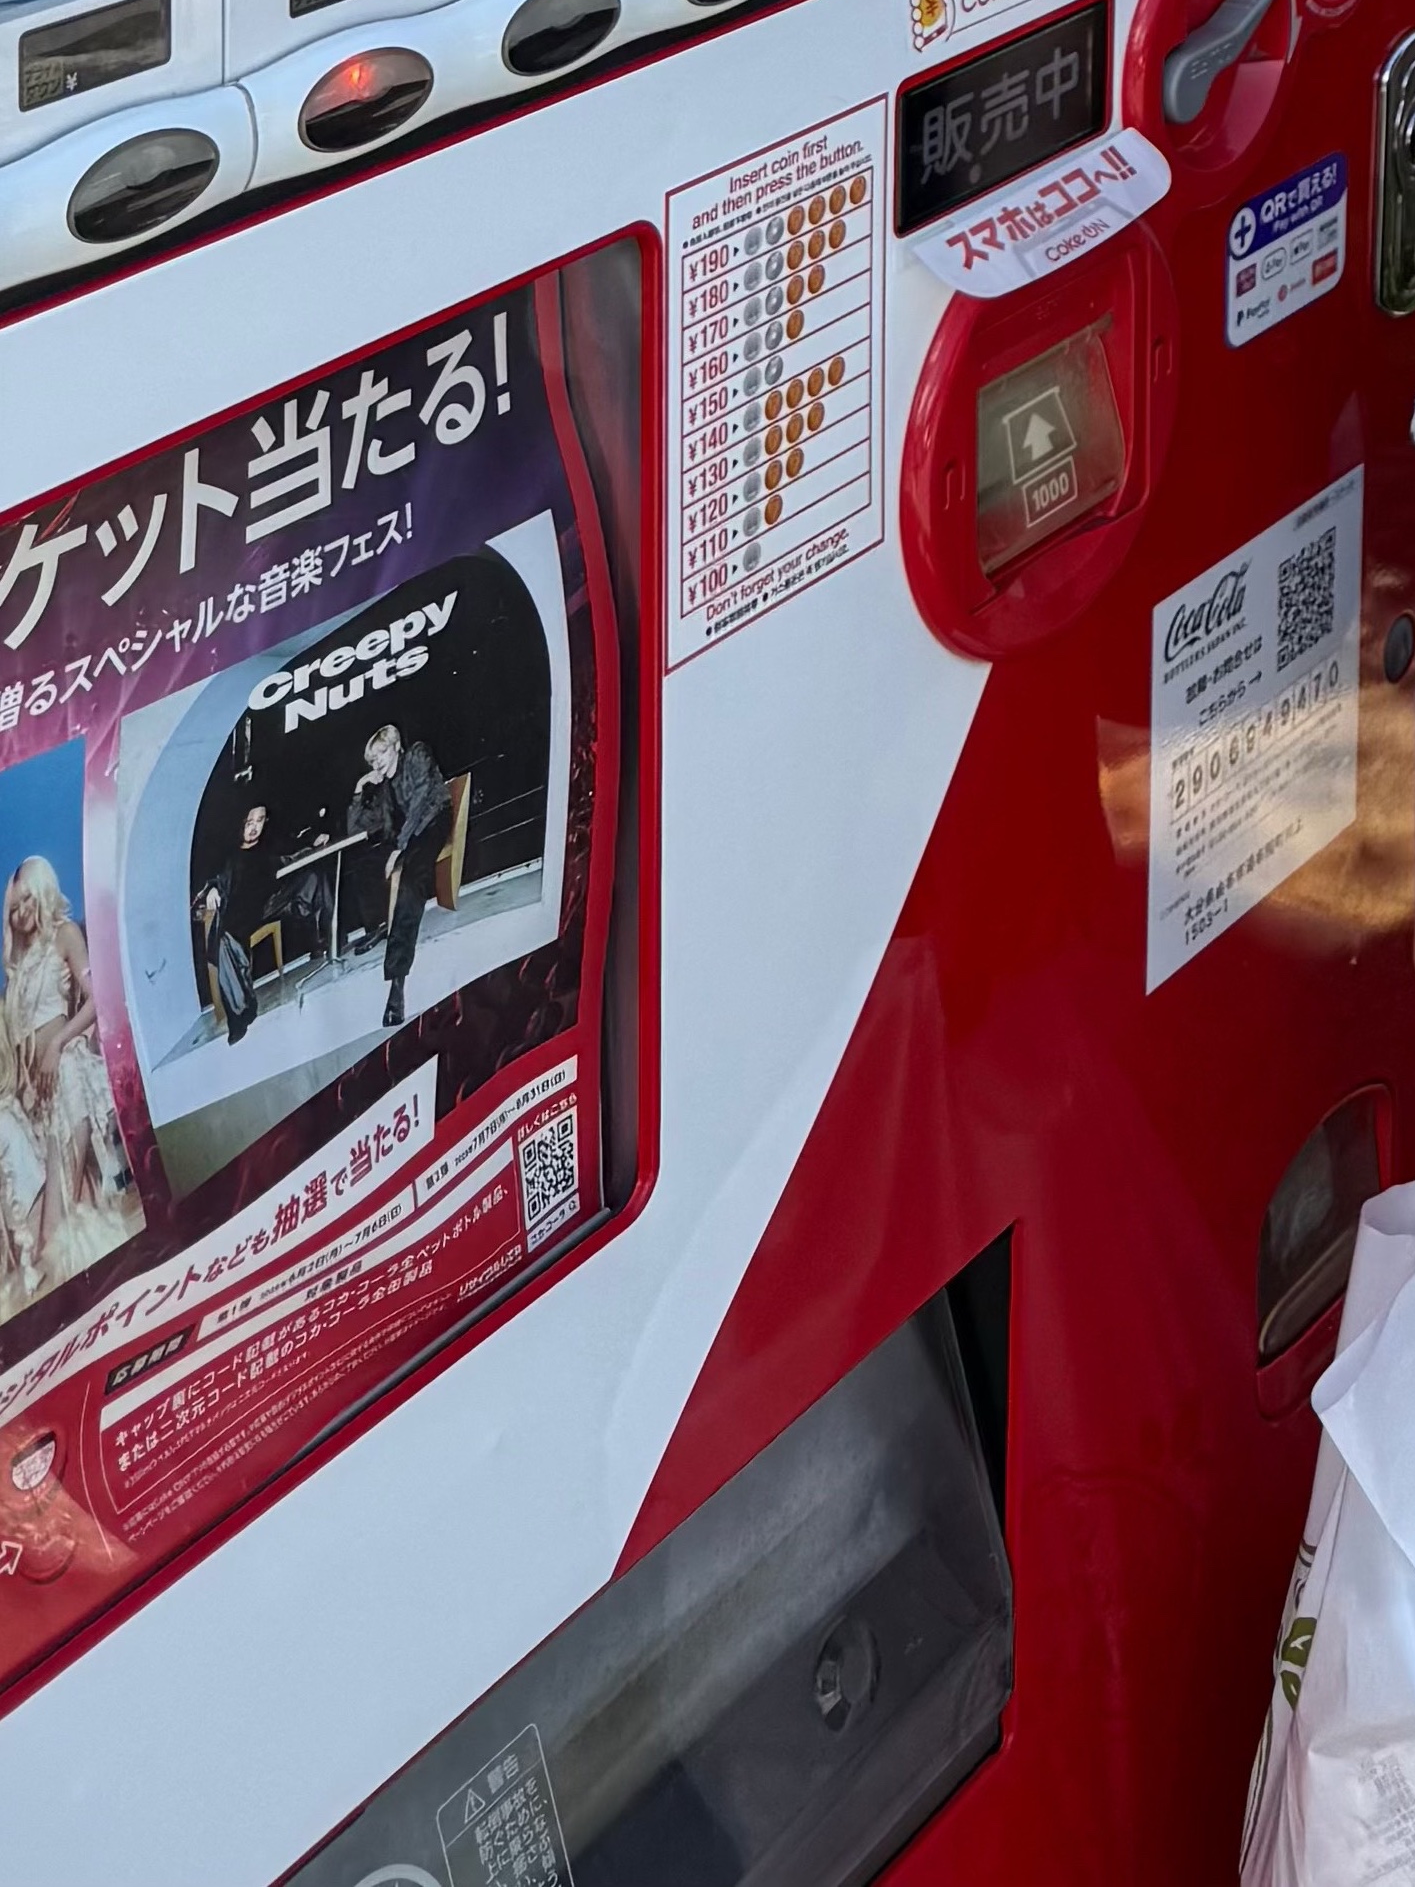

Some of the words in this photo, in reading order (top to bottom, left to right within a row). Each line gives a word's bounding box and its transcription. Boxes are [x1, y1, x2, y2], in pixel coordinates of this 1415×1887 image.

[919, 43, 1079, 186] 販売中
[729, 161, 769, 194] Insert
[771, 151, 801, 177] coin
[802, 135, 829, 164] first
[691, 200, 719, 231] and
[721, 188, 752, 219] then
[755, 175, 793, 205] press
[795, 163, 817, 187] the
[818, 140, 865, 175] button.
[1259, 161, 1339, 225] QRで買える!
[944, 144, 1138, 271] スマホはココへ!!
[689, 249, 730, 282] ¥190
[689, 284, 730, 317] ¥180
[689, 320, 730, 353] ¥170
[689, 356, 730, 389] ¥160
[689, 392, 730, 425] ¥150
[689, 427, 730, 460] ¥140
[2, 310, 510, 653] ケット当たる!
[689, 463, 730, 496] ¥130
[1029, 473, 1071, 513] 1000
[689, 497, 730, 531] ¥120
[689, 531, 730, 567] ¥110
[689, 567, 730, 603] ¥100
[706, 594, 739, 623] Don't
[740, 571, 775, 604] forget
[776, 557, 804, 585] your
[1164, 555, 1253, 664] Coca-Cola
[282, 641, 430, 734] Nuts
